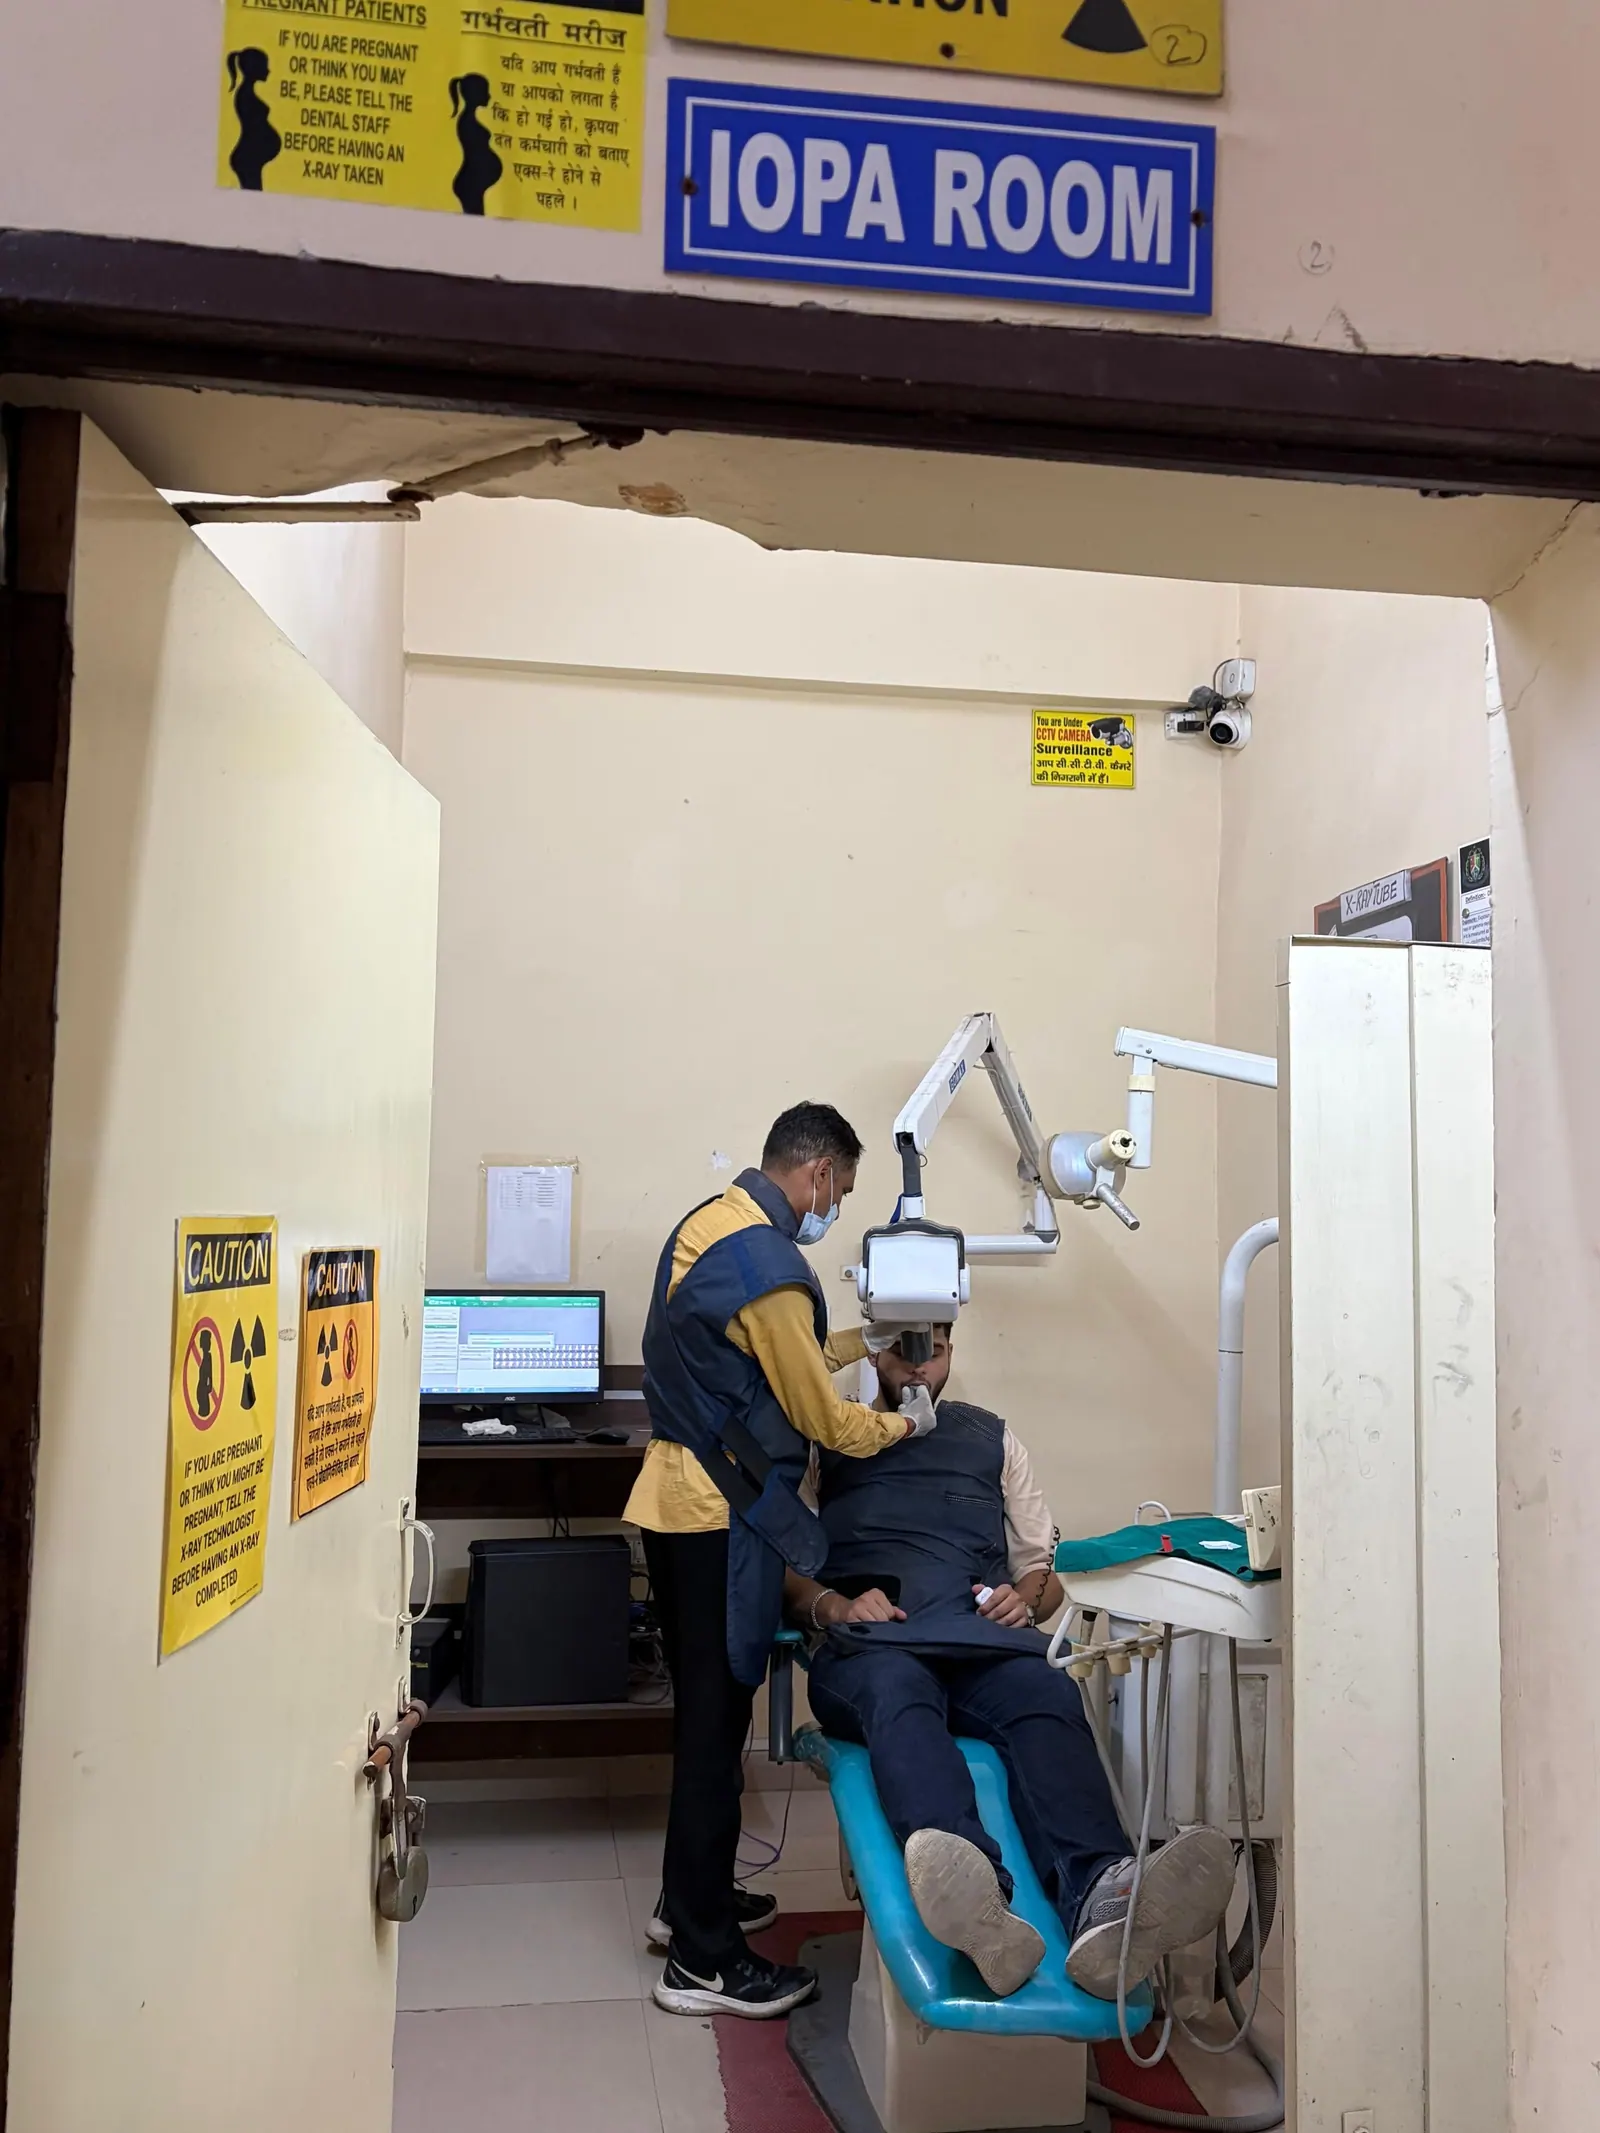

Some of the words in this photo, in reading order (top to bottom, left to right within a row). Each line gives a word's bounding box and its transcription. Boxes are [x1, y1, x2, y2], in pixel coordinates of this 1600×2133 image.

[345, 0, 427, 25] PATIENTS
[461, 7, 549, 38] गर्भवती
[562, 19, 627, 48] मरीज
[279, 29, 290, 46] IF
[294, 32, 319, 50] YOU
[322, 35, 348, 54] ARE
[351, 37, 418, 62] PREGNANT
[289, 56, 307, 74] OR
[312, 58, 347, 79] THINK
[351, 64, 376, 83] YOU
[380, 66, 406, 85] MAY
[500, 53, 523, 72] यदि
[532, 60, 556, 75] आप
[563, 60, 605, 81] गर्भवती
[280, 80, 300, 102] BE,
[304, 83, 352, 105] PLEASE
[356, 89, 385, 110] TELL
[389, 93, 413, 112] THE
[501, 82, 514, 97] या
[522, 83, 563, 102] आपको
[570, 90, 604, 107] लगता
[301, 108, 348, 130] DENTAL
[352, 114, 390, 134] STAFF
[492, 103, 509, 122] कि
[516, 106, 530, 127] हो
[536, 108, 553, 130] गई
[584, 117, 619, 136] कृपया
[284, 132, 335, 155] BEFORE
[338, 138, 384, 160] HAVING
[387, 145, 405, 162] AN
[519, 134, 568, 155] कर्मचारी
[574, 139, 591, 158] को
[303, 160, 340, 180] X-RAY
[343, 164, 383, 185] TAKEN
[513, 160, 555, 183] एक्स-रे
[562, 163, 583, 184] होने
[590, 166, 602, 187] से
[536, 188, 565, 209] पहले
[709, 129, 905, 242] IOPA
[933, 148, 1173, 265] ROOM
[1036, 728, 1056, 740] CCTV
[1058, 729, 1091, 742] CAMERA
[1037, 716, 1048, 726] You
[1051, 718, 1062, 727] are
[1063, 717, 1083, 728] Under
[1036, 743, 1113, 756] Surveillance
[1036, 759, 1054, 768] आप
[1036, 771, 1048, 781] की
[187, 1239, 268, 1286] CAUTION
[317, 1261, 364, 1297] CAUTION
[184, 1460, 192, 1478] IF
[194, 1454, 210, 1475] YOU
[210, 1448, 226, 1469] ARE
[227, 1434, 262, 1461] PREGNANT
[180, 1489, 190, 1508] OR
[192, 1478, 215, 1502] THINK
[216, 1471, 232, 1491] YOU
[232, 1462, 255, 1485] MIGHT
[256, 1458, 264, 1475] BE
[184, 1500, 224, 1533] PREGNANT,
[226, 1492, 241, 1512] TELL
[243, 1485, 256, 1504] THE
[180, 1536, 202, 1563] X-RAY
[204, 1509, 256, 1549] TECHNOLOGIST
[172, 1563, 200, 1595] BEFORE
[201, 1548, 228, 1577] HAVING
[229, 1541, 239, 1561] AN
[240, 1531, 260, 1555] X-RAY
[196, 1569, 238, 1607] COMPLETED
